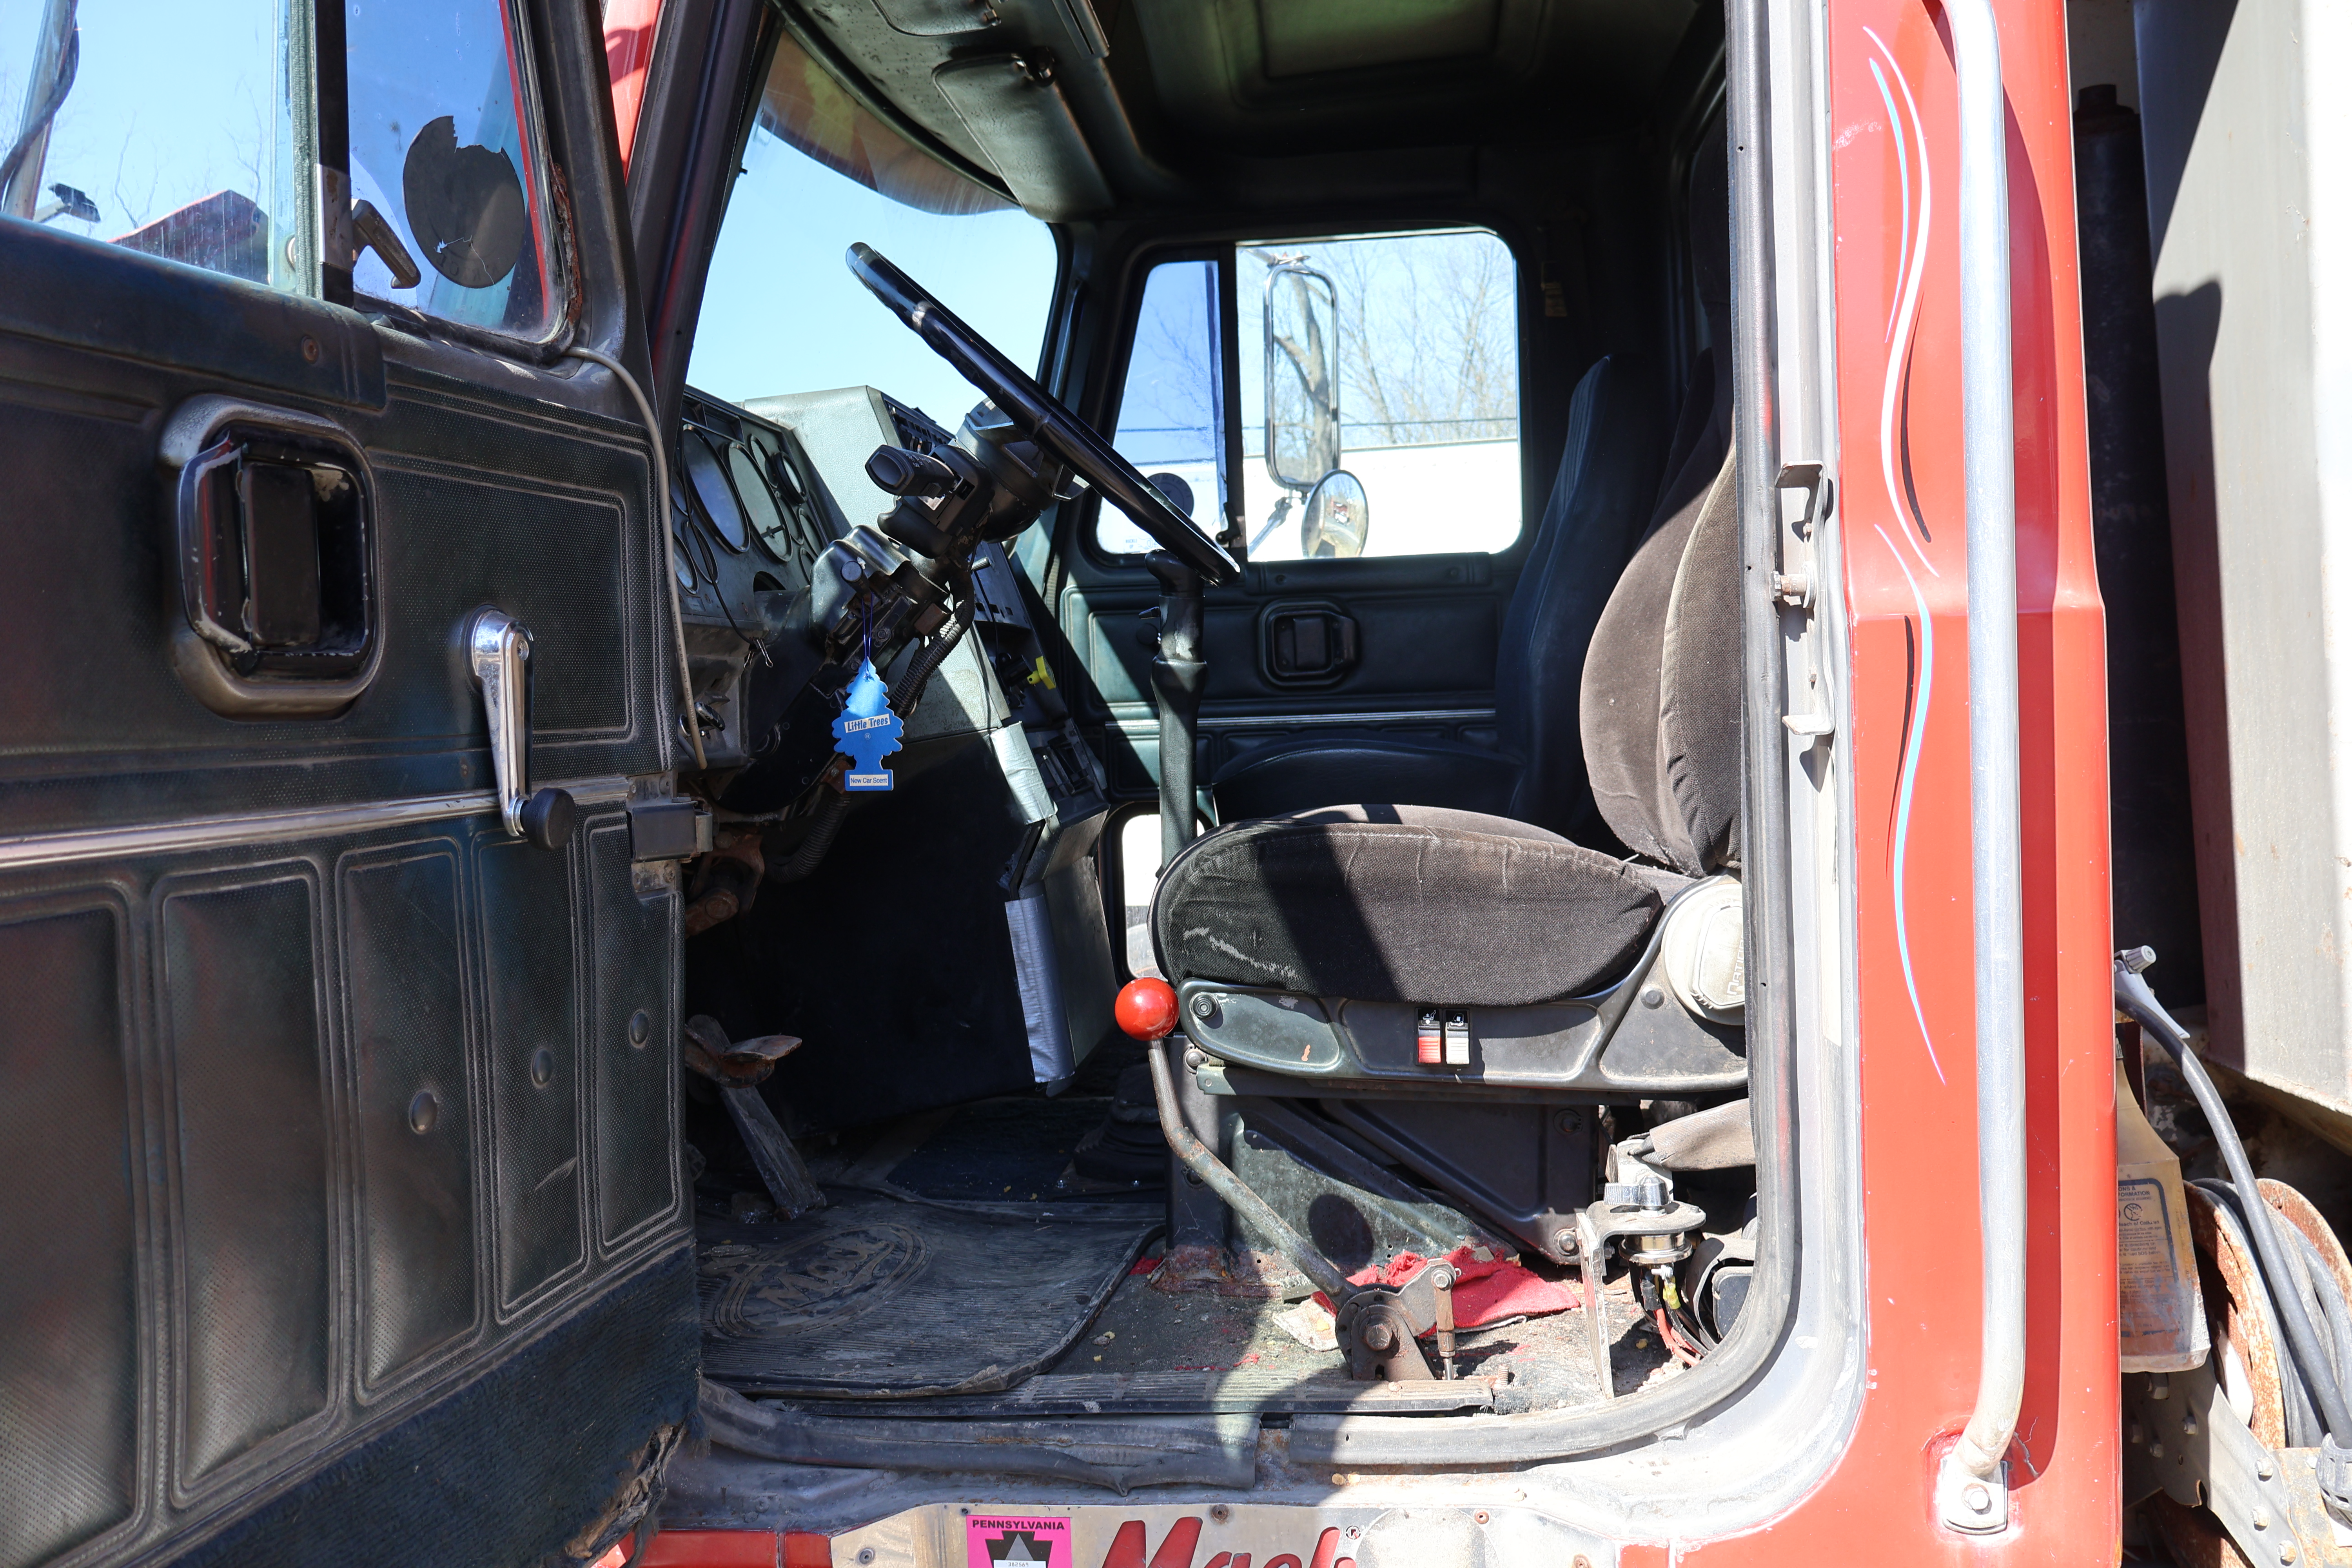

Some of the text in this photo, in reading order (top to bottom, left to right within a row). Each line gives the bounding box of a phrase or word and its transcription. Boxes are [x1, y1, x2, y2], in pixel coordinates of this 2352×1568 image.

[848, 717, 888, 732] Little Trees
[972, 1519, 1065, 1530] PENNSYLVANIA
[1102, 1516, 1357, 1568] Mk
